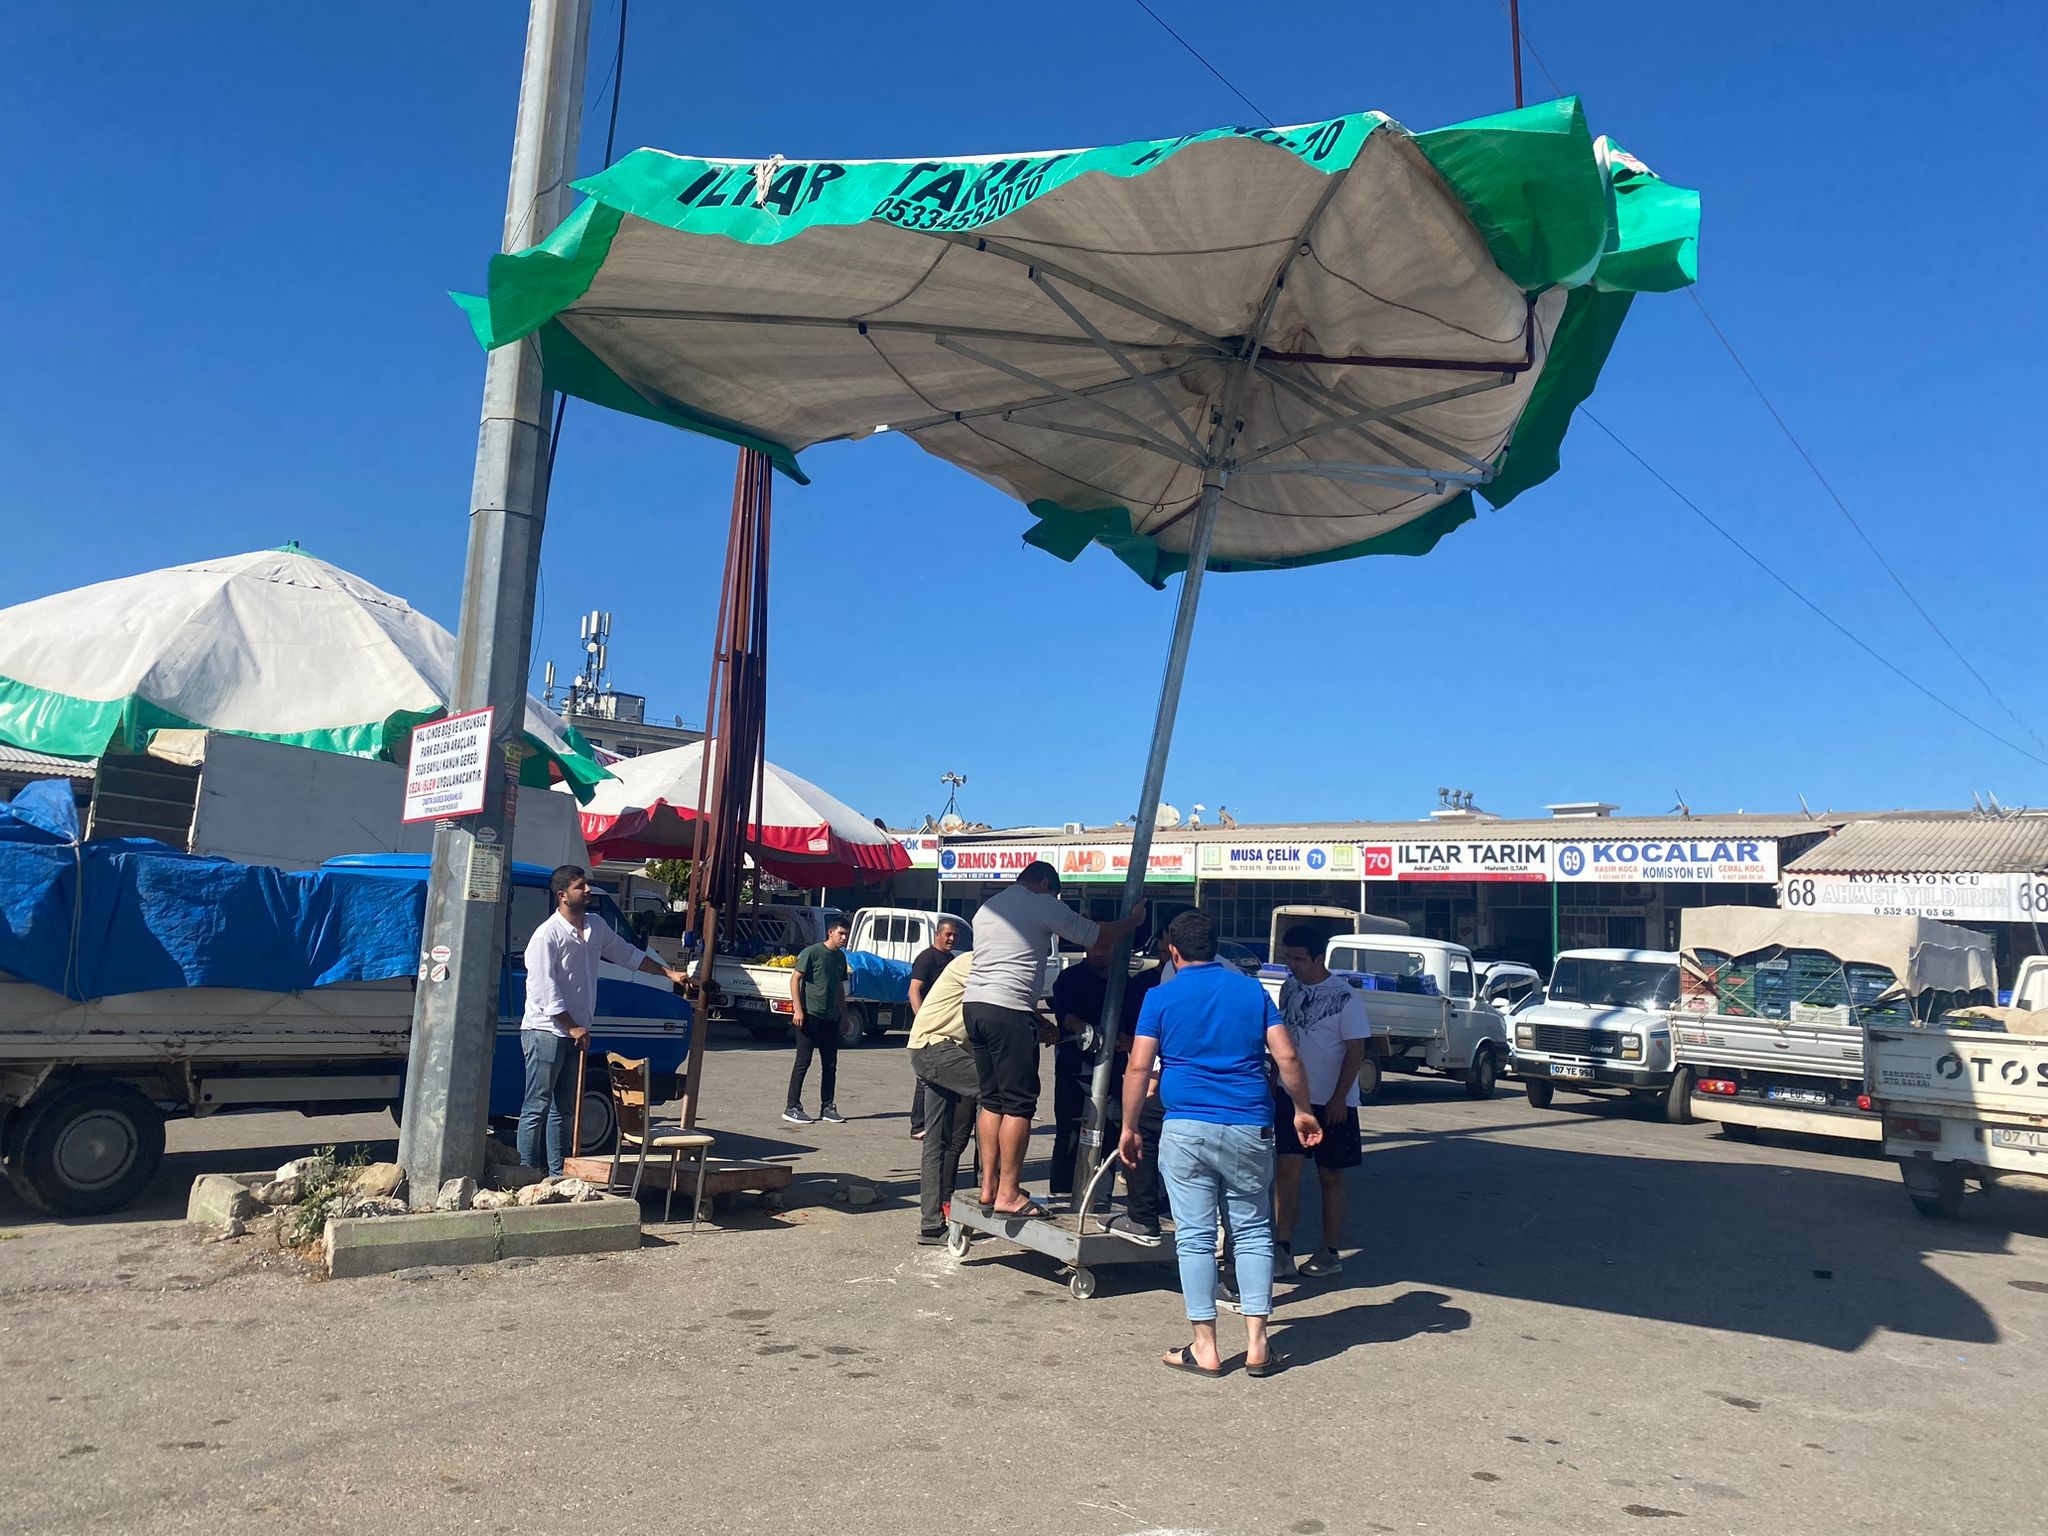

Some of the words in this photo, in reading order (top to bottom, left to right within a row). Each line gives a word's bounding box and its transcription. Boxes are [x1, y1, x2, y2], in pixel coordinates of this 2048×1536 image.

[871, 173, 1044, 231] 05334552070
[421, 745, 433, 758] PARK
[451, 735, 477, 752] ARAÇLARA
[957, 852, 997, 869] ERMUS
[1000, 851, 1038, 868] TARIM
[1149, 855, 1183, 867] TARIM
[1230, 849, 1263, 861] MUSA
[1266, 846, 1300, 864] ÇELİK
[1311, 853, 1322, 865] 71
[1367, 853, 1390, 869] 70
[1398, 845, 1462, 864] ILTAR
[1467, 844, 1546, 864] TARIM
[1563, 851, 1580, 871] 69
[1593, 843, 1760, 863] KOCALAR
[1697, 864, 1713, 879] EVİ
[1787, 879, 1816, 906] 68
[1823, 884, 1898, 905] AHMET
[1904, 886, 2009, 908] YILDIRIM
[2018, 882, 2048, 912] 68
[1874, 907, 1880, 915] 0
[1883, 907, 1901, 916] 532
[1942, 909, 1955, 917] 68
[1555, 1065, 1564, 1074] 07
[1566, 1066, 1578, 1076] YE
[1579, 1068, 1593, 1077] 994
[1774, 1087, 1785, 1097] 07
[2002, 1130, 2021, 1143] 07
